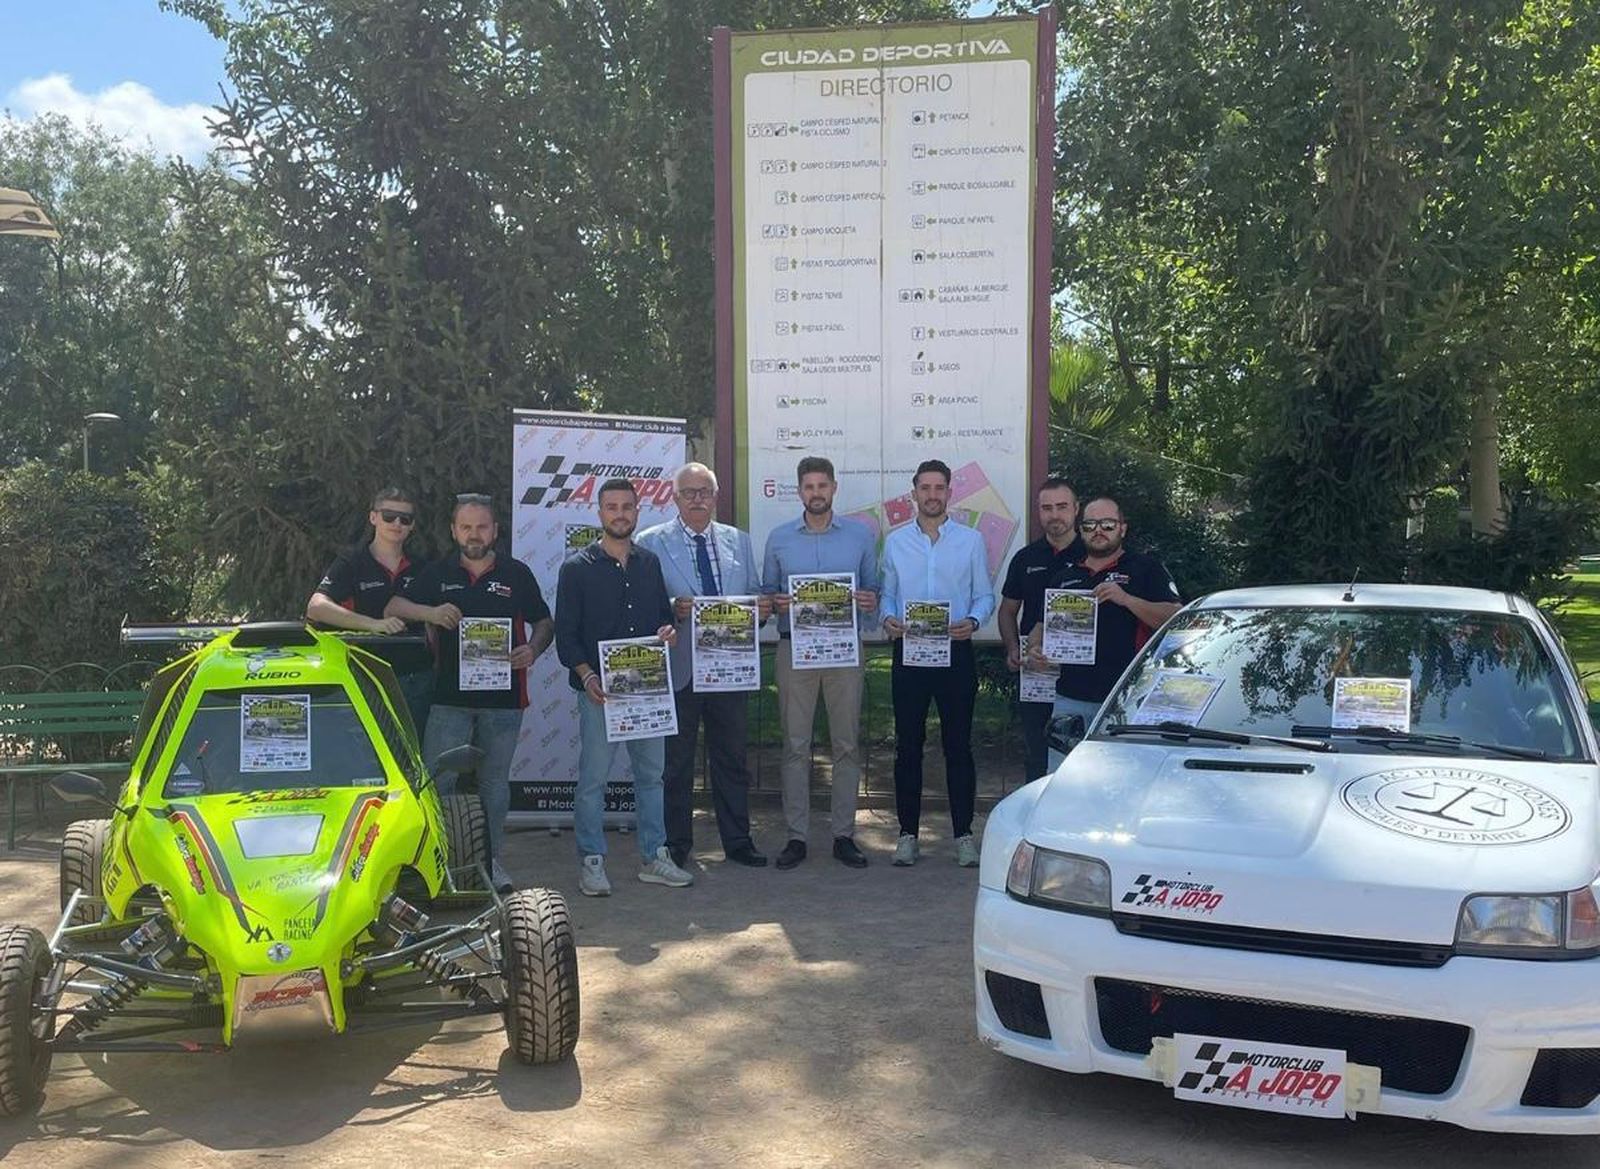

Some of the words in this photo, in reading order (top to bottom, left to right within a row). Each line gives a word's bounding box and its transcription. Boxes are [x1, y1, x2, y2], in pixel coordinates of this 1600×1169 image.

[760, 50, 855, 66] CIUDAD
[862, 39, 1011, 63] DEPORTIVA
[820, 74, 953, 97] DIRECTORIO
[939, 113, 969, 121] PETANCA
[800, 118, 824, 128] CAMPO
[801, 128, 820, 137] PISTA
[939, 147, 970, 157] CIRCUITO
[800, 161, 824, 170] CAMPO
[851, 159, 880, 168] NATURAL
[939, 182, 965, 191] PARQUE
[800, 194, 824, 203] CAMPO
[851, 191, 886, 201] ARTIFICIAL
[939, 216, 965, 225] PARQUE
[801, 227, 824, 236] CAMPO
[824, 225, 856, 235] MOQUETA
[801, 260, 823, 269] PISTAS
[824, 257, 877, 268] POLIDEPORTIVAS
[801, 292, 823, 300] PISTAS
[824, 291, 843, 300] TENIS
[801, 324, 823, 333] PISTAS
[938, 328, 979, 338] VESTUARIOS
[979, 327, 1018, 337] CENTRALES
[938, 363, 961, 372] ASEOS
[802, 398, 827, 406] PISCINA
[644, 423, 659, 432] club
[938, 430, 952, 438] BAR
[957, 428, 1004, 437] RESTAURANTE
[585, 463, 664, 479] MOTORCLUB
[568, 474, 597, 504] A
[245, 671, 302, 681] RUBIO
[1415, 769, 1560, 820] PERITACIONES
[1438, 831, 1465, 841] DE
[1470, 830, 1527, 841] PARTE
[1163, 880, 1215, 892] MOTORCLUB
[1153, 888, 1170, 905] A
[1171, 891, 1224, 910] JOPO
[1242, 1053, 1325, 1073] MOTORCLUB
[1225, 1066, 1253, 1092] A
[1258, 1068, 1342, 1101] JOPO
